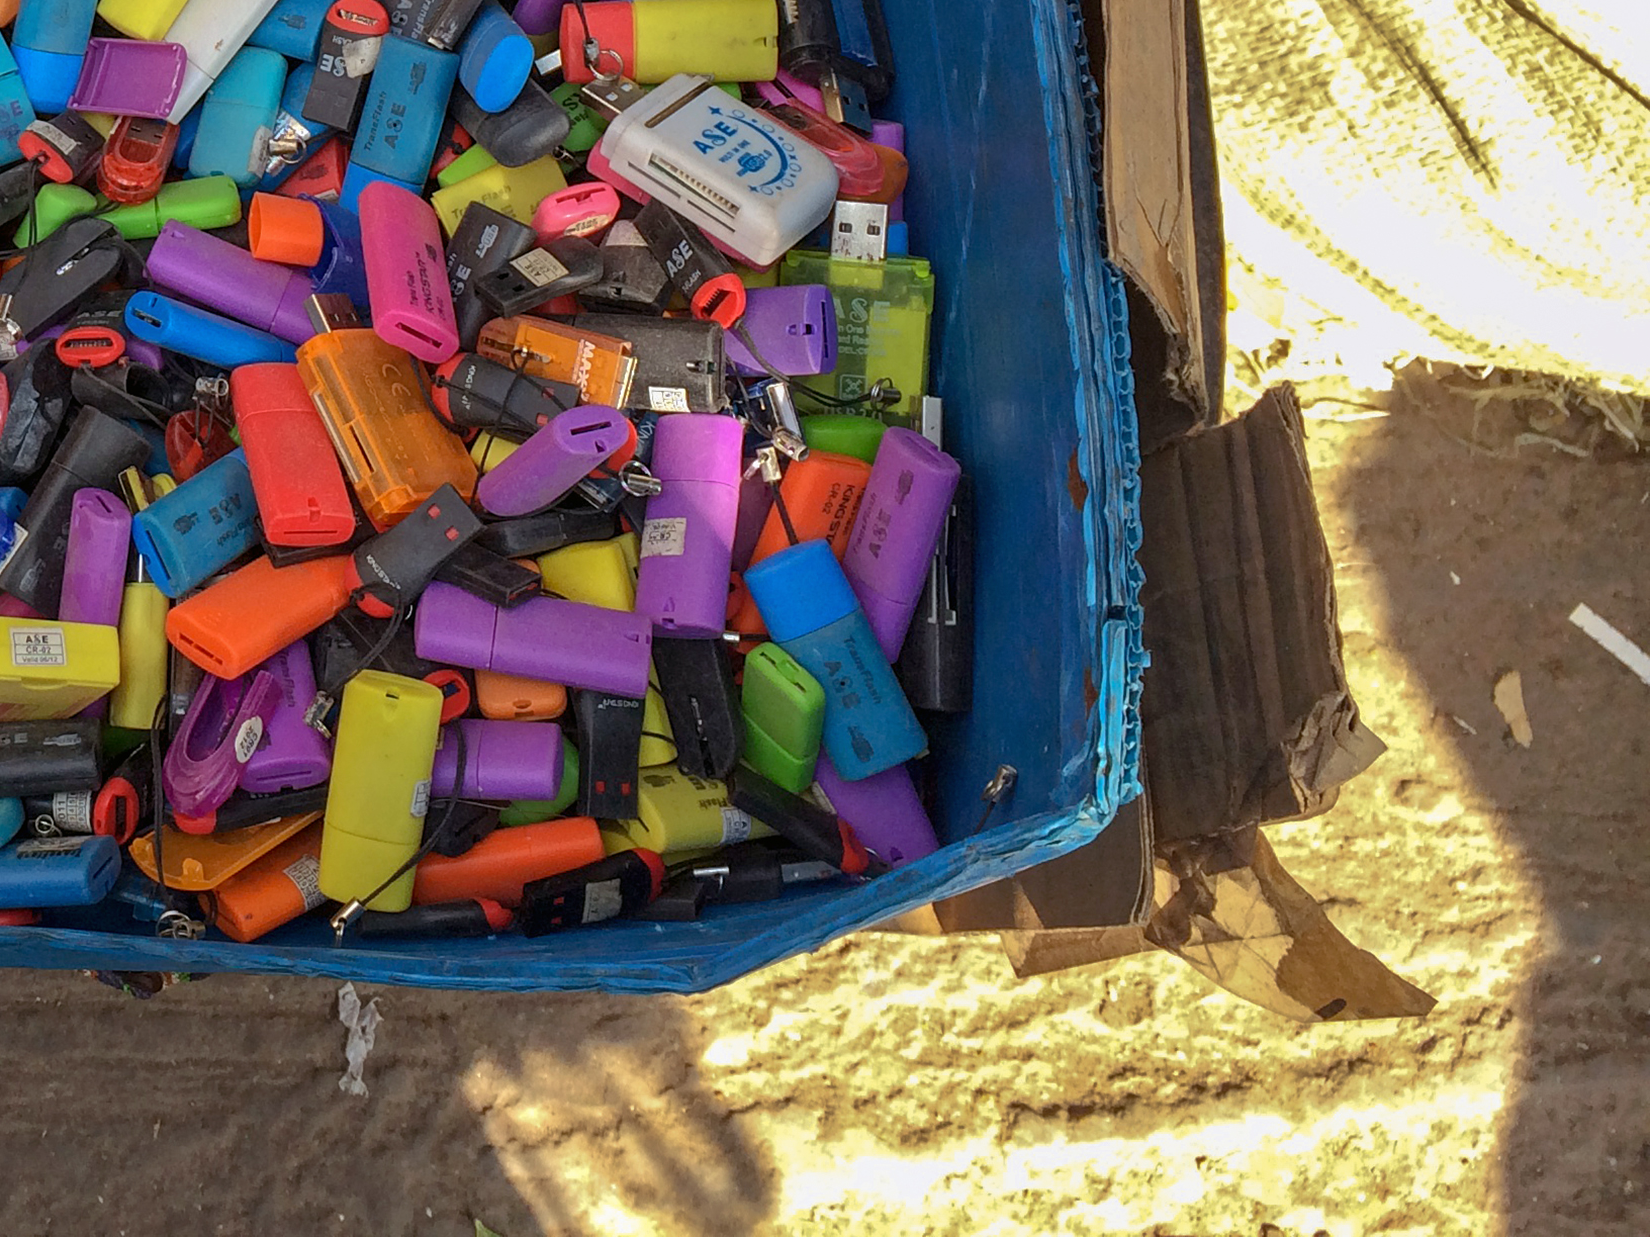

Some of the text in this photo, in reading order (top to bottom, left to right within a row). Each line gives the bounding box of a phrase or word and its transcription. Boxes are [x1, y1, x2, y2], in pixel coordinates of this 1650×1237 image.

[362, 89, 390, 153] TransFlash
[379, 101, 410, 150] ASE
[690, 118, 741, 158] ASE
[662, 238, 698, 278] ASE
[25, 633, 48, 644] ASE
